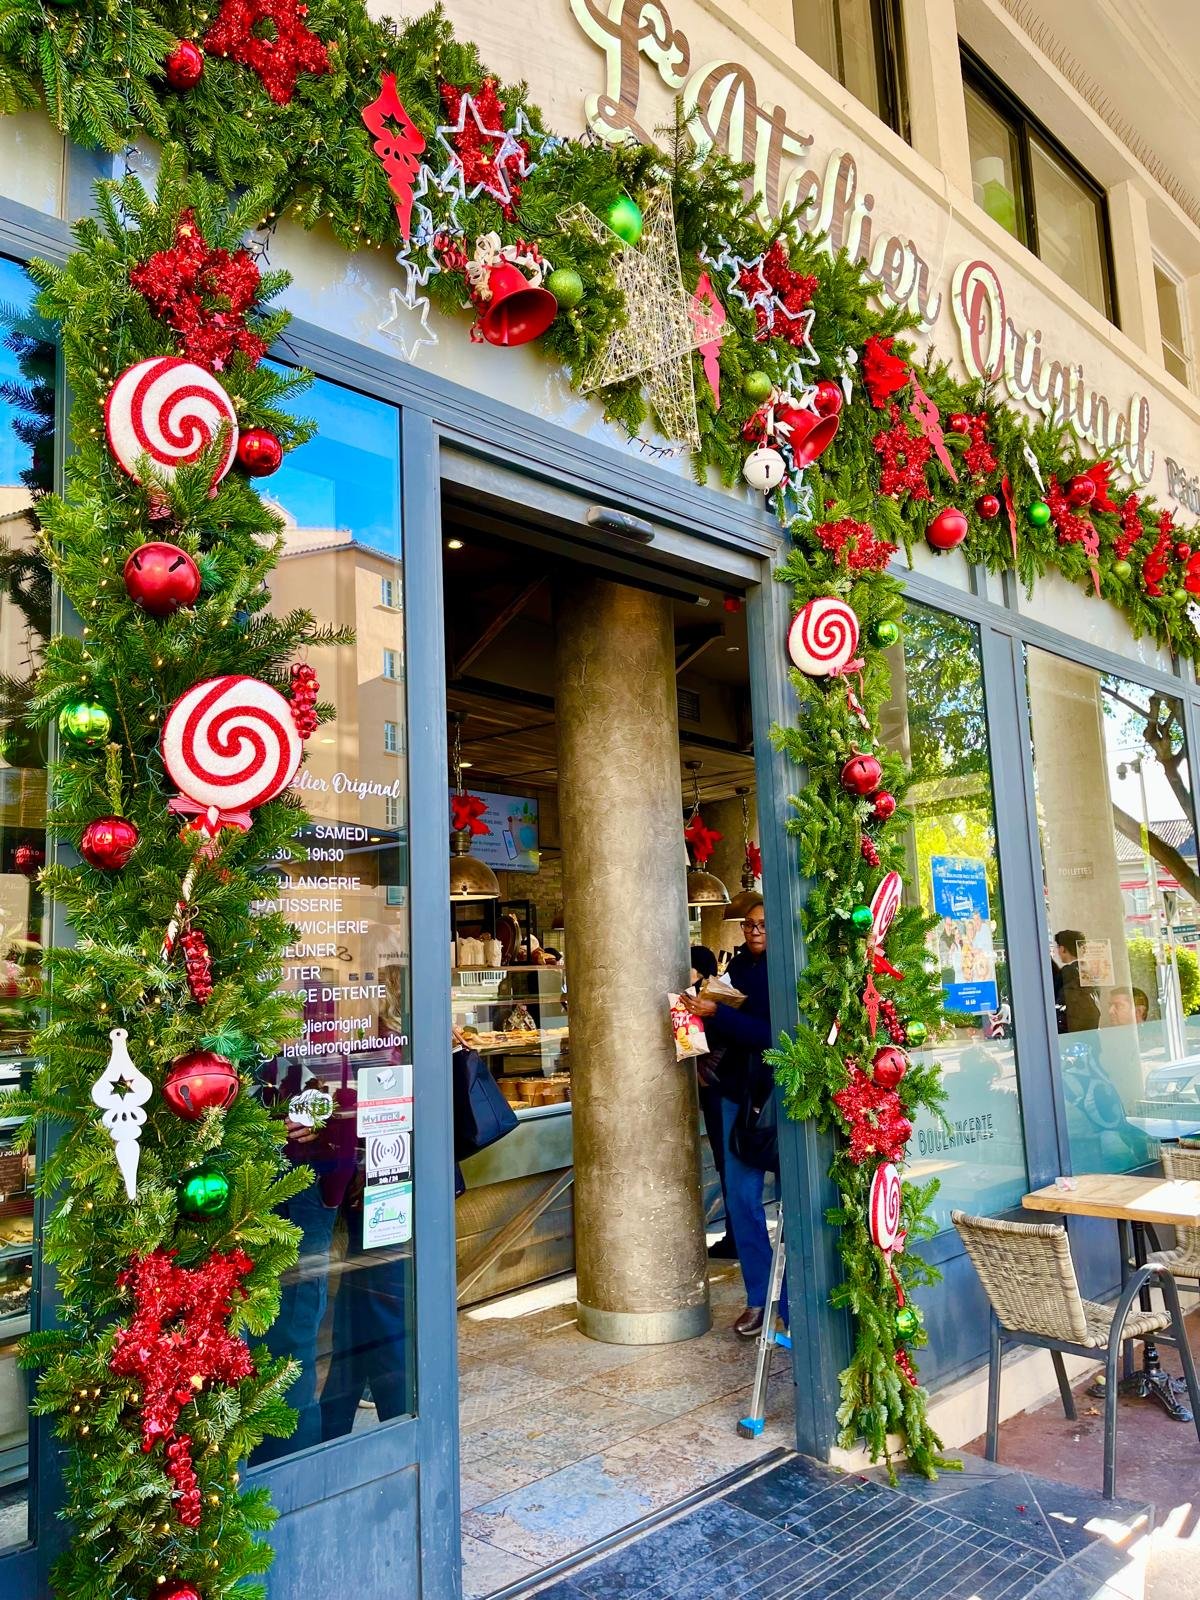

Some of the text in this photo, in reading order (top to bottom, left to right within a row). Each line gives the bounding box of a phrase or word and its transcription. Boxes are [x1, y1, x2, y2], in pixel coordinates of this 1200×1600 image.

[952, 260, 1154, 486] Original
[288, 769, 400, 799] elier Original
[315, 825, 368, 842] SAMEDI
[306, 847, 344, 862] 19h30
[257, 876, 360, 890] ULANGERIE
[279, 943, 336, 958] JEUNER
[322, 984, 386, 1002] DETENTE
[300, 1014, 372, 1034] elieroriginal
[284, 1034, 408, 1058] latelieroriginaltoulon
